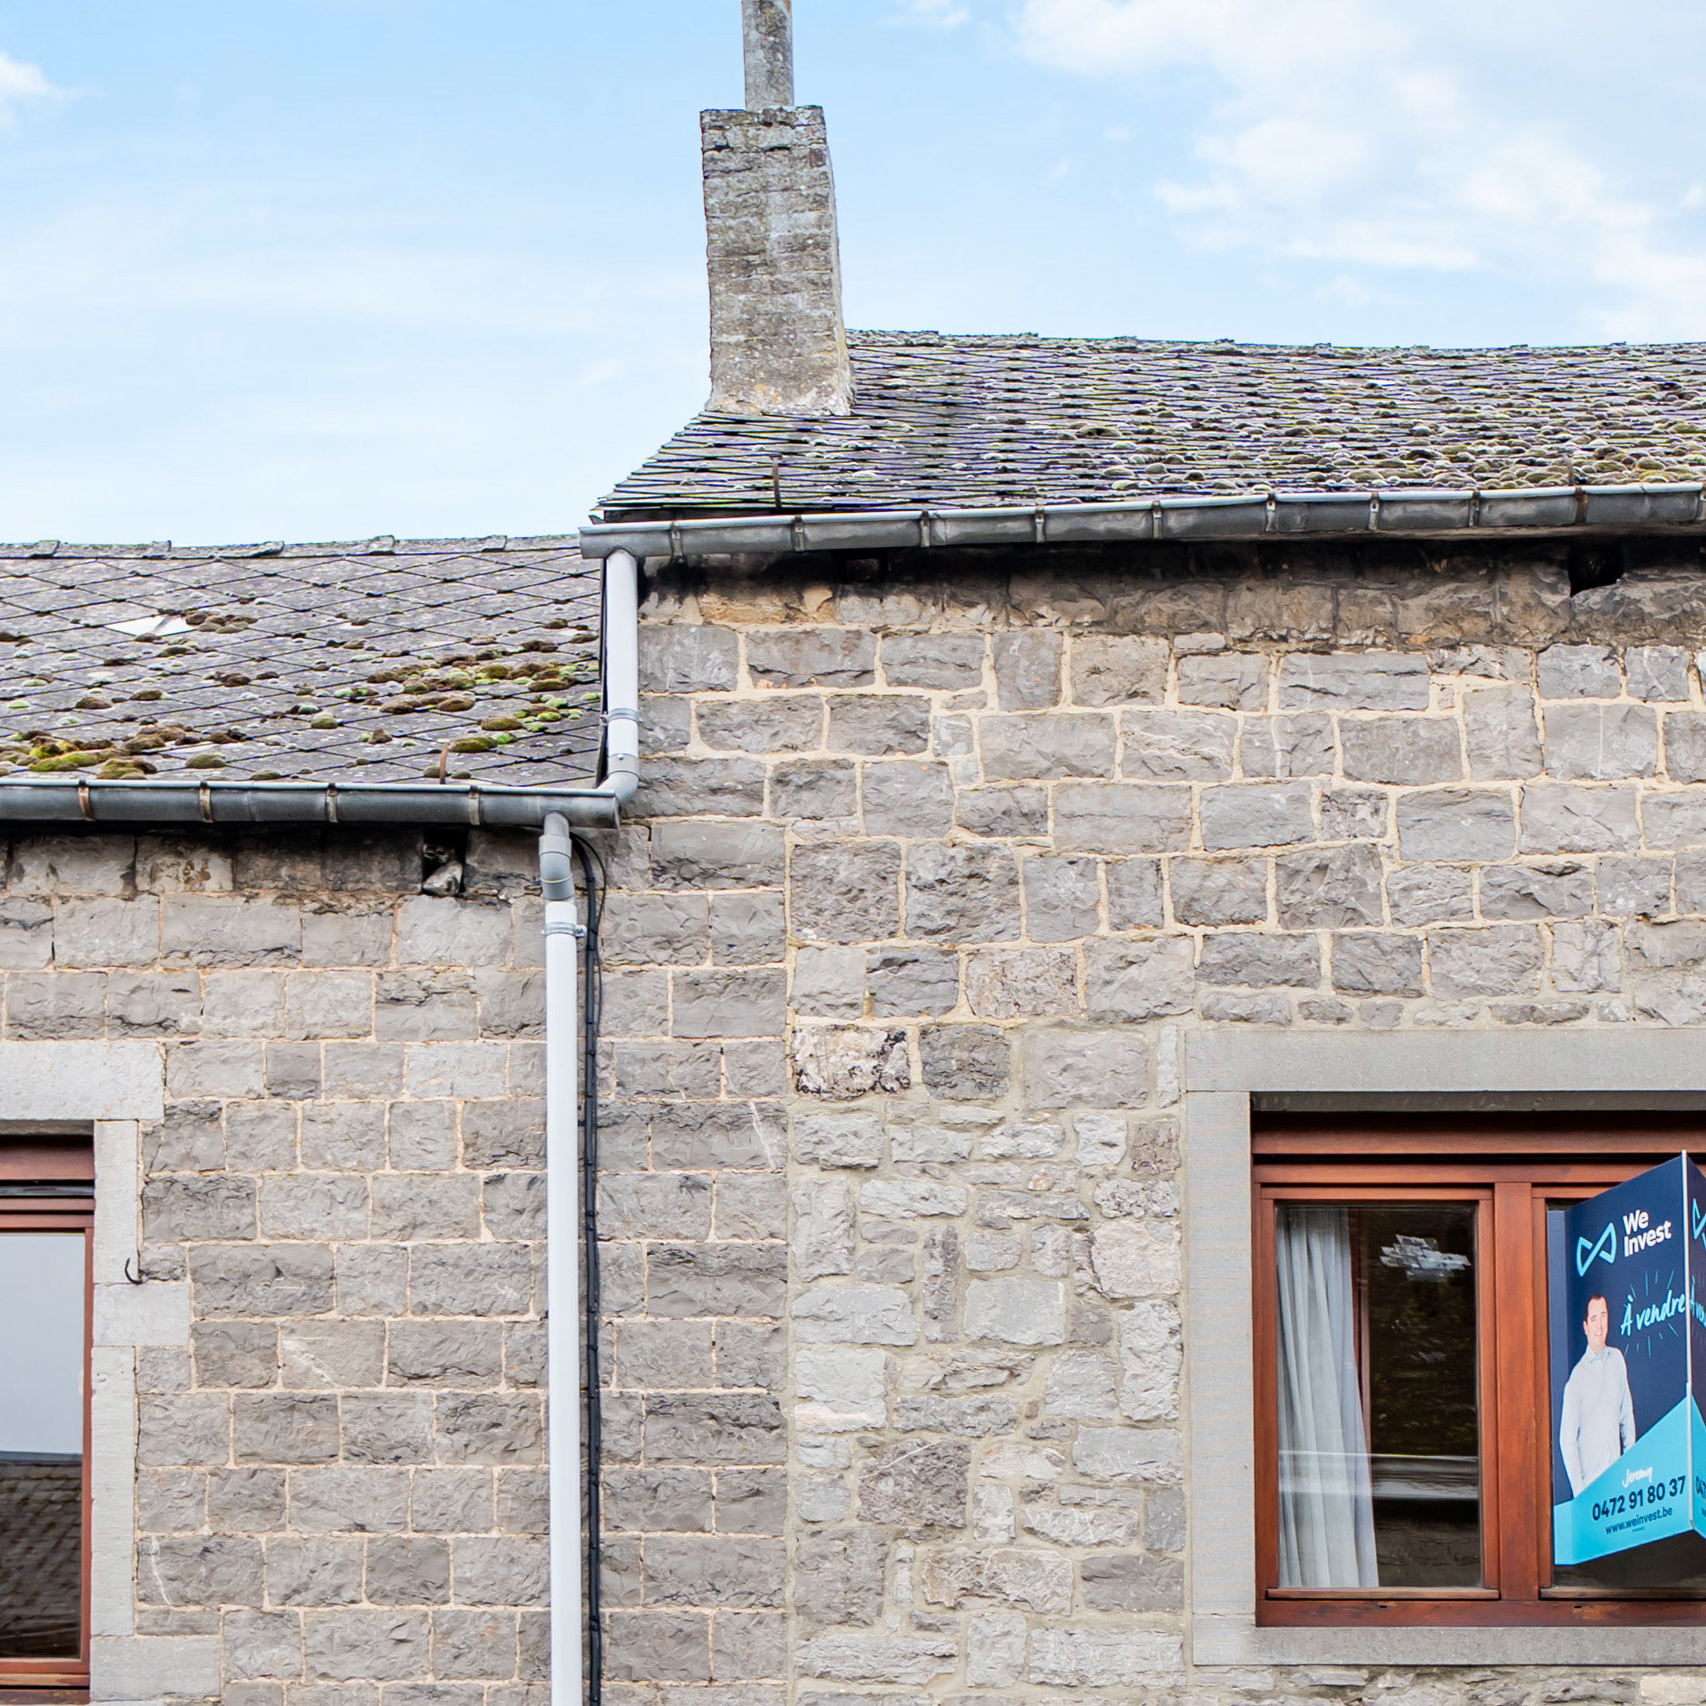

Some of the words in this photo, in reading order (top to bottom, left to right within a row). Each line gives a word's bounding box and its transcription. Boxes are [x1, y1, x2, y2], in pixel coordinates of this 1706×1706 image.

[1623, 1209, 1649, 1235] We
[1624, 1220, 1672, 1257] Invest
[1620, 1294, 1634, 1336] À
[1636, 1289, 1685, 1331] vendre
[1592, 1494, 1625, 1521] 0472
[1628, 1488, 1643, 1509] 91
[1647, 1482, 1665, 1504] 80
[1669, 1475, 1686, 1497] 37
[1605, 1506, 1673, 1534] www.weinvest.be
